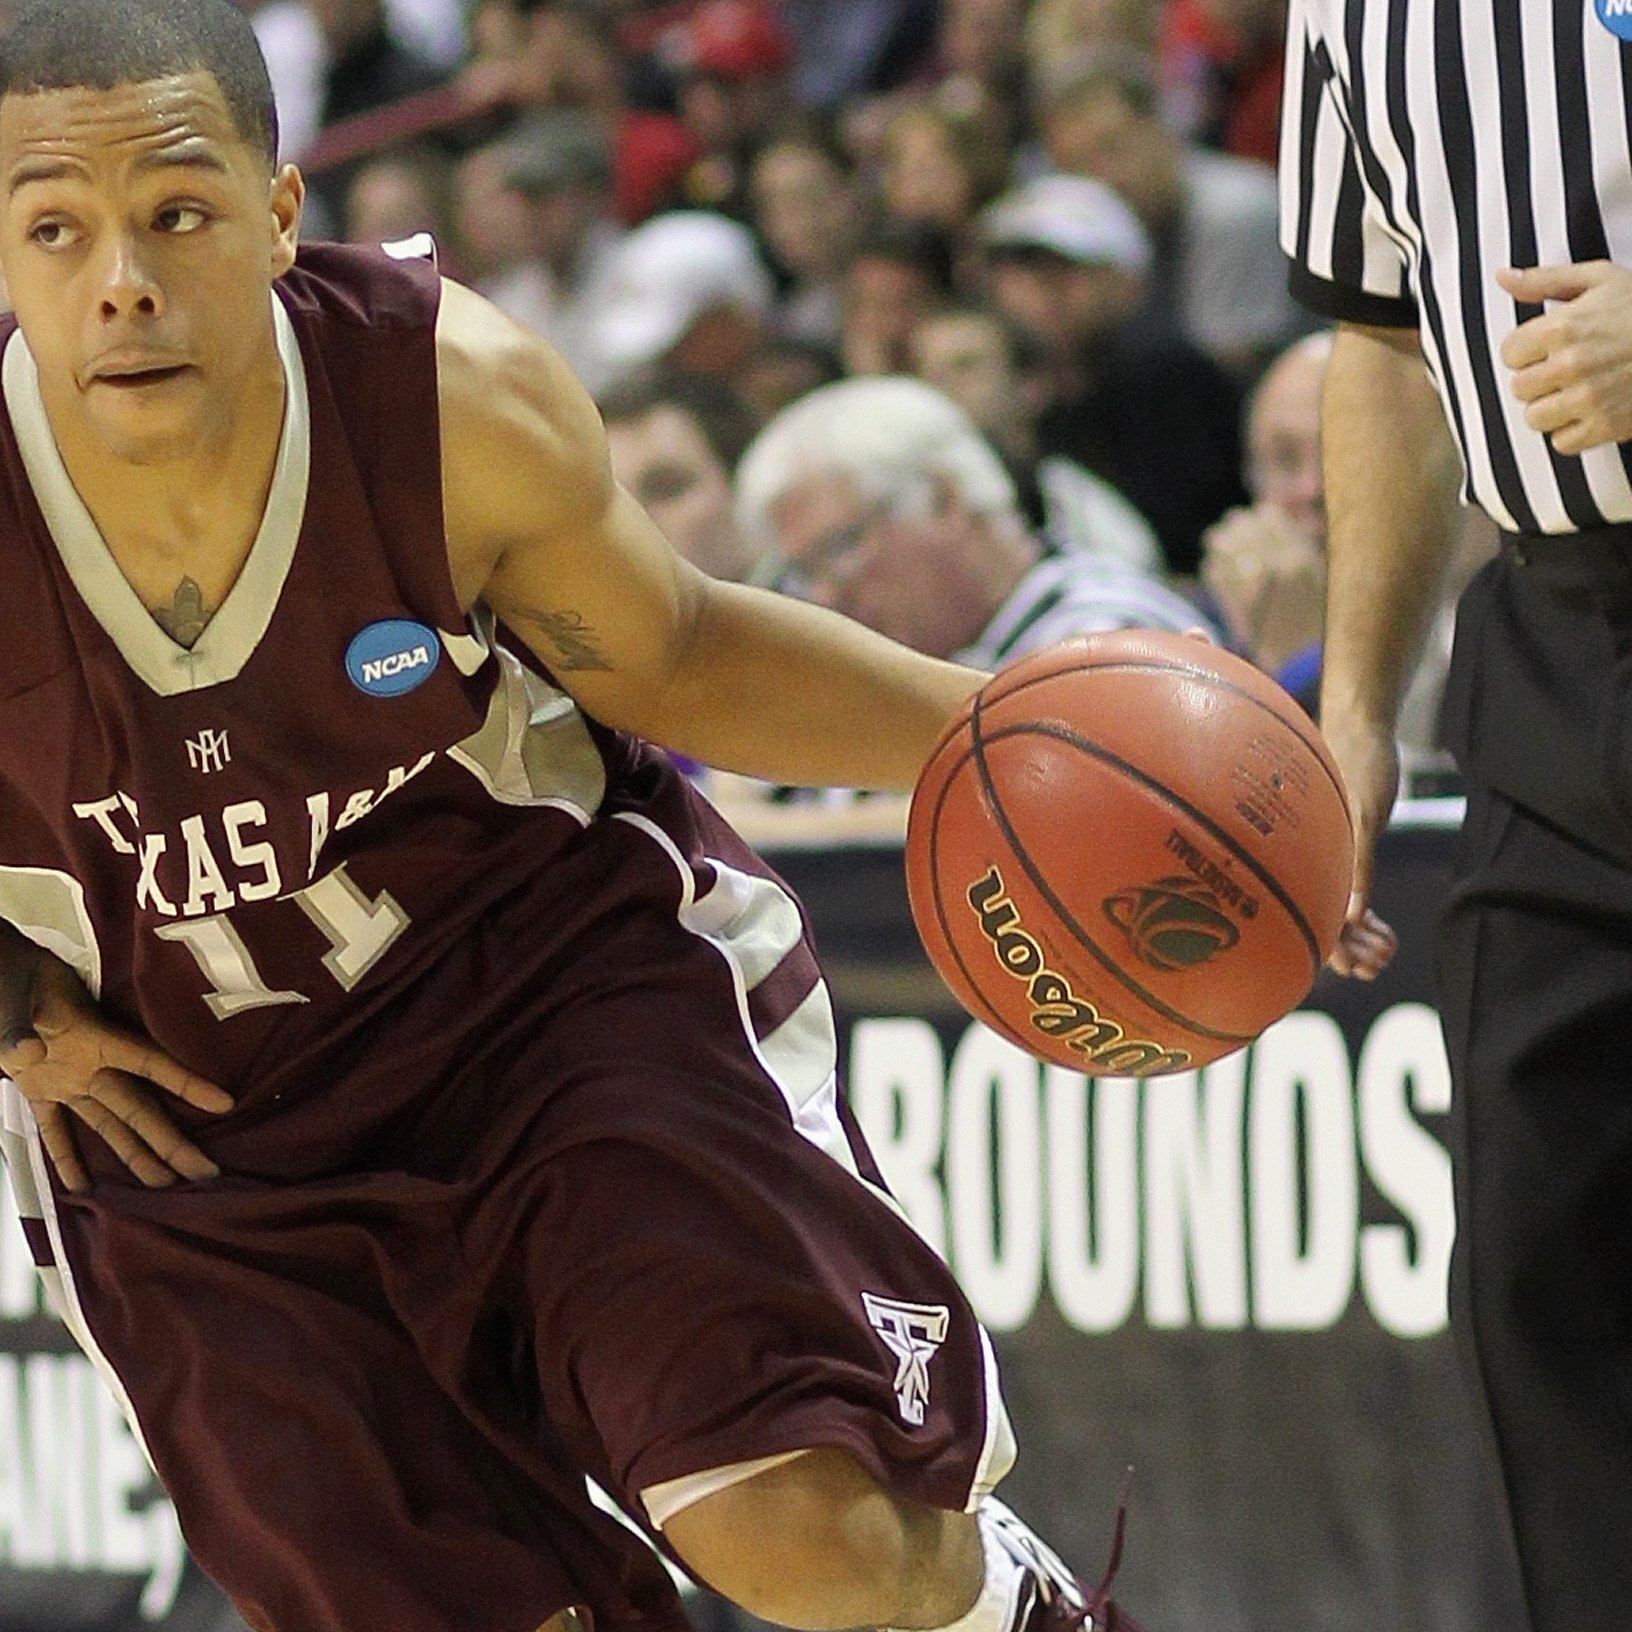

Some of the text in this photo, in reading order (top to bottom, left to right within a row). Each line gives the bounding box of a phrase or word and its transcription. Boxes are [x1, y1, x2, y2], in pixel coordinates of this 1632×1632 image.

[362, 646, 429, 684] NCAA
[72, 790, 282, 917] TXAS
[154, 861, 412, 1022] 11
[967, 863, 1192, 1076] Wilson
[848, 1002, 1457, 1338] ROUNDS
